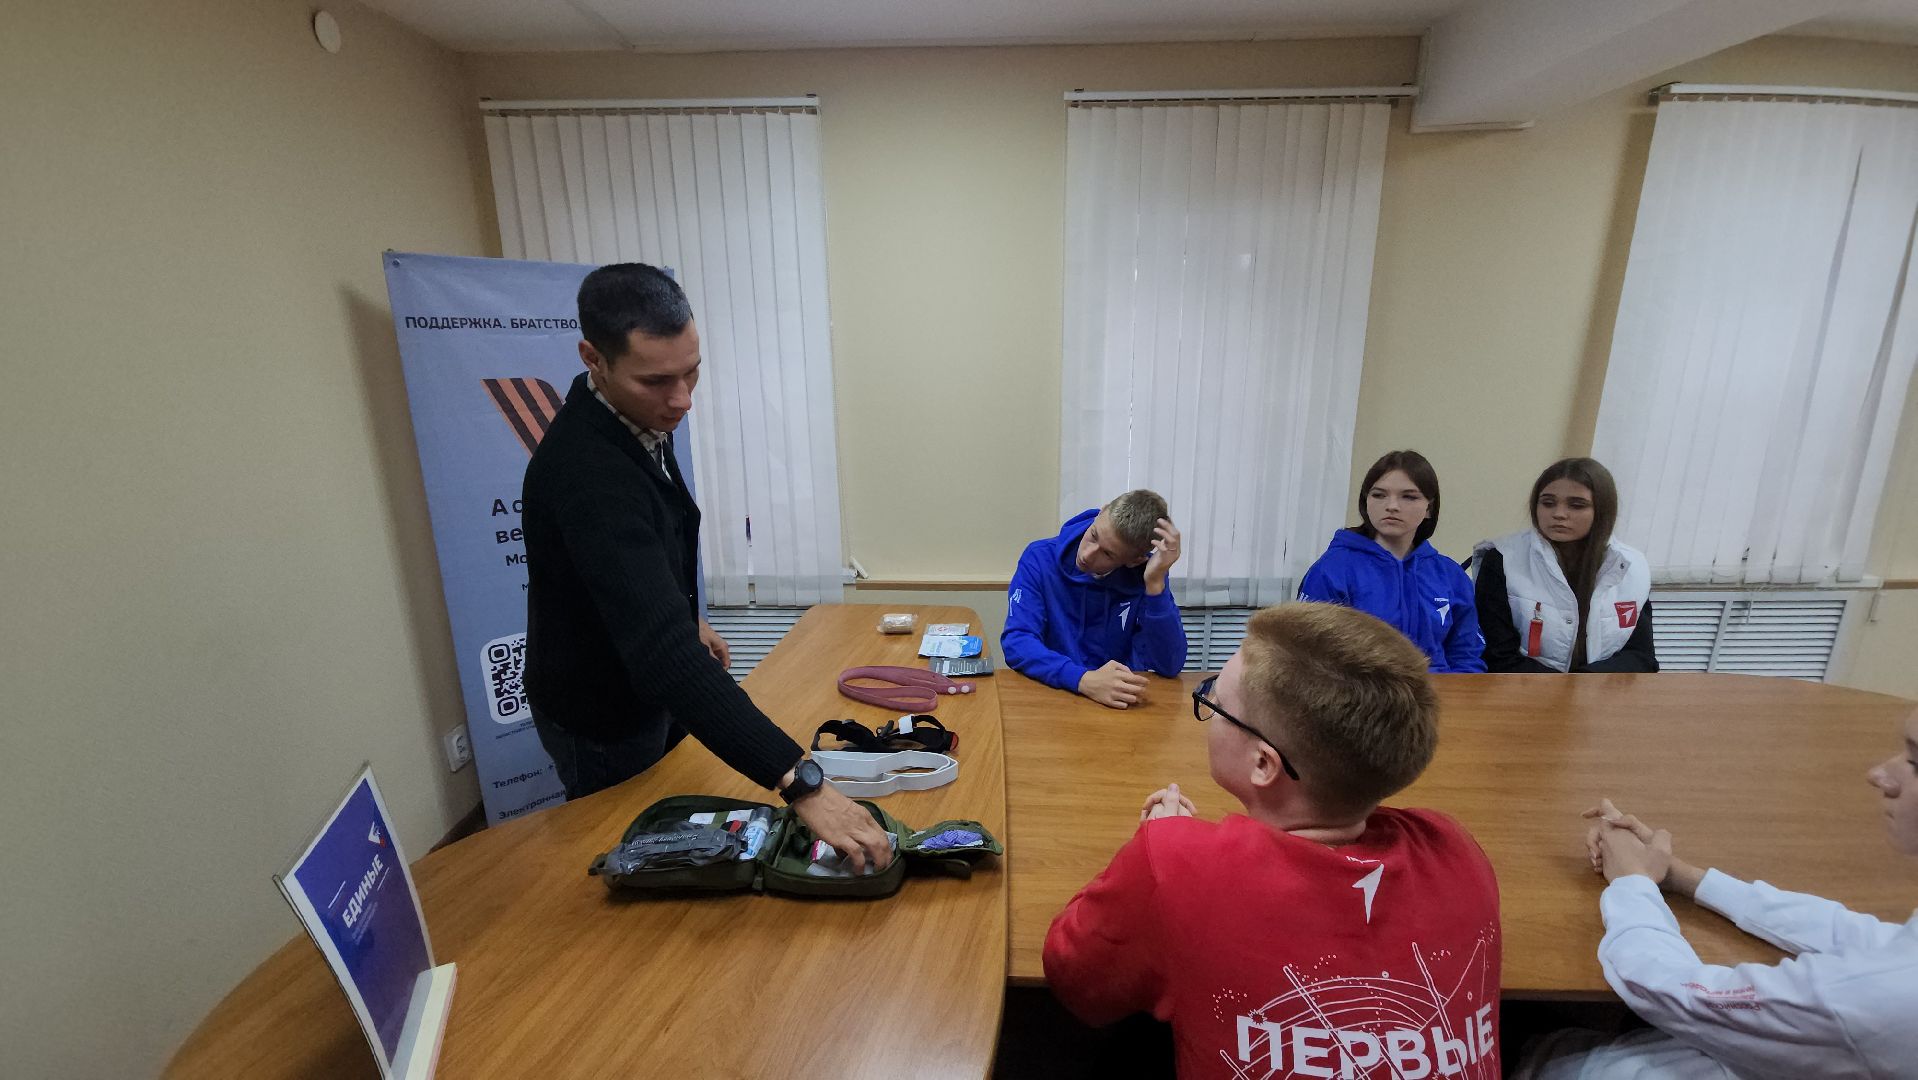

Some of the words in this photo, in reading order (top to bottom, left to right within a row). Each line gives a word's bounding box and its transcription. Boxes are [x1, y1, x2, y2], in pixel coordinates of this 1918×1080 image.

[405, 316, 506, 330] ПОДДЕРЖКА.
[511, 318, 581, 330] БРАТСТВО.
[492, 768, 543, 789] Телефон:
[342, 854, 384, 929] ЕДИНЫЕ
[1236, 1002, 1495, 1080] ПЕРВЫЕ
